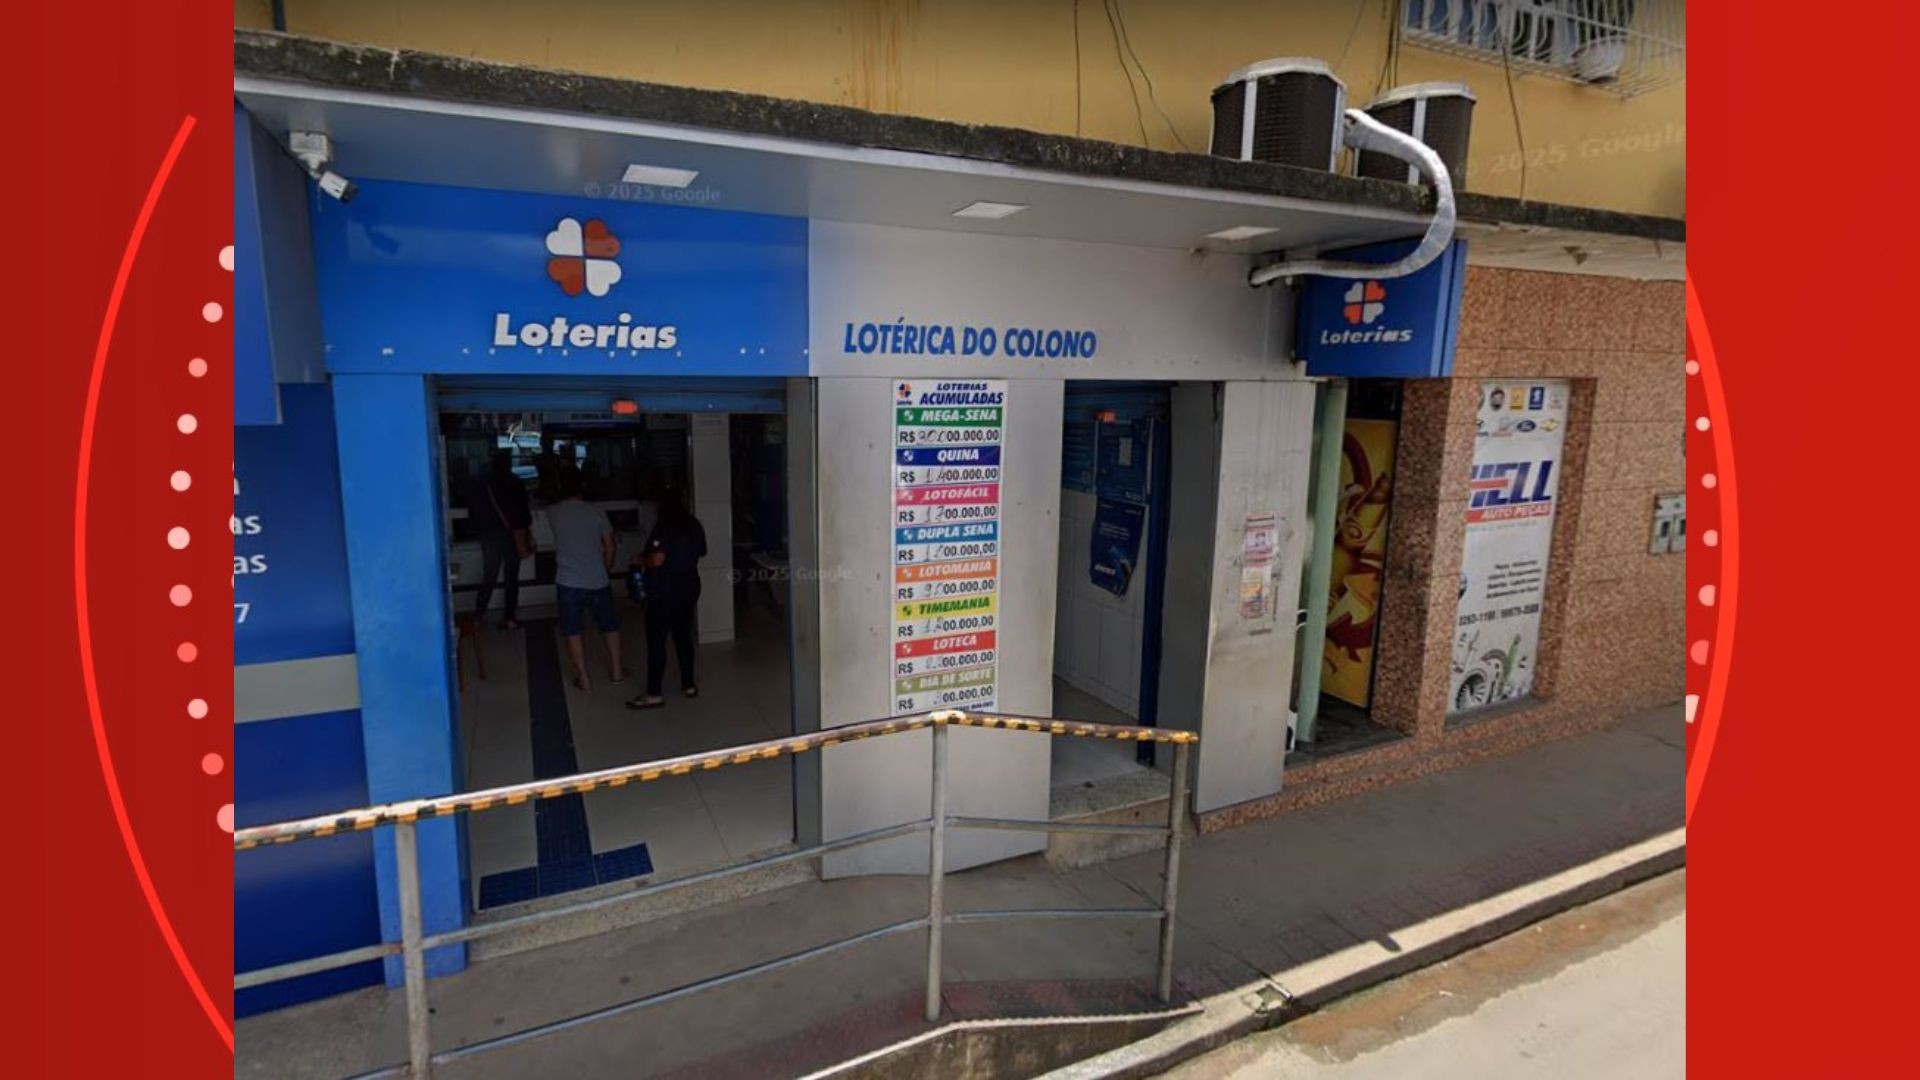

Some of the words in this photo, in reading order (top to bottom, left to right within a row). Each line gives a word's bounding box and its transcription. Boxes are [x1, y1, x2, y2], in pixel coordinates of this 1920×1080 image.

[494, 312, 677, 349] Loterias
[844, 316, 956, 355] LOTÉRICA
[961, 327, 997, 356] DO
[1003, 328, 1097, 358] COLONO
[1320, 325, 1413, 345] Loterias
[936, 383, 988, 391] LOTERIAS
[919, 392, 1004, 405] ACUMULADAS
[920, 409, 998, 422] MEGA-SENA
[899, 431, 916, 443] R$
[937, 449, 980, 463] QUINA
[900, 471, 915, 482] R$
[899, 510, 915, 522] R$
[917, 526, 960, 540] DUPLA
[962, 523, 994, 537] SENA
[898, 549, 914, 561] R$
[918, 562, 992, 578] LOTOMANIA
[898, 588, 914, 599] R$
[919, 597, 991, 615] TIMEMANIA
[898, 625, 913, 637] R$
[933, 635, 978, 650] LOTECA
[898, 662, 913, 674] R$
[919, 675, 940, 689] DIA
[942, 673, 956, 686] DE
[958, 669, 992, 682] SORTE
[898, 698, 914, 710] R$
